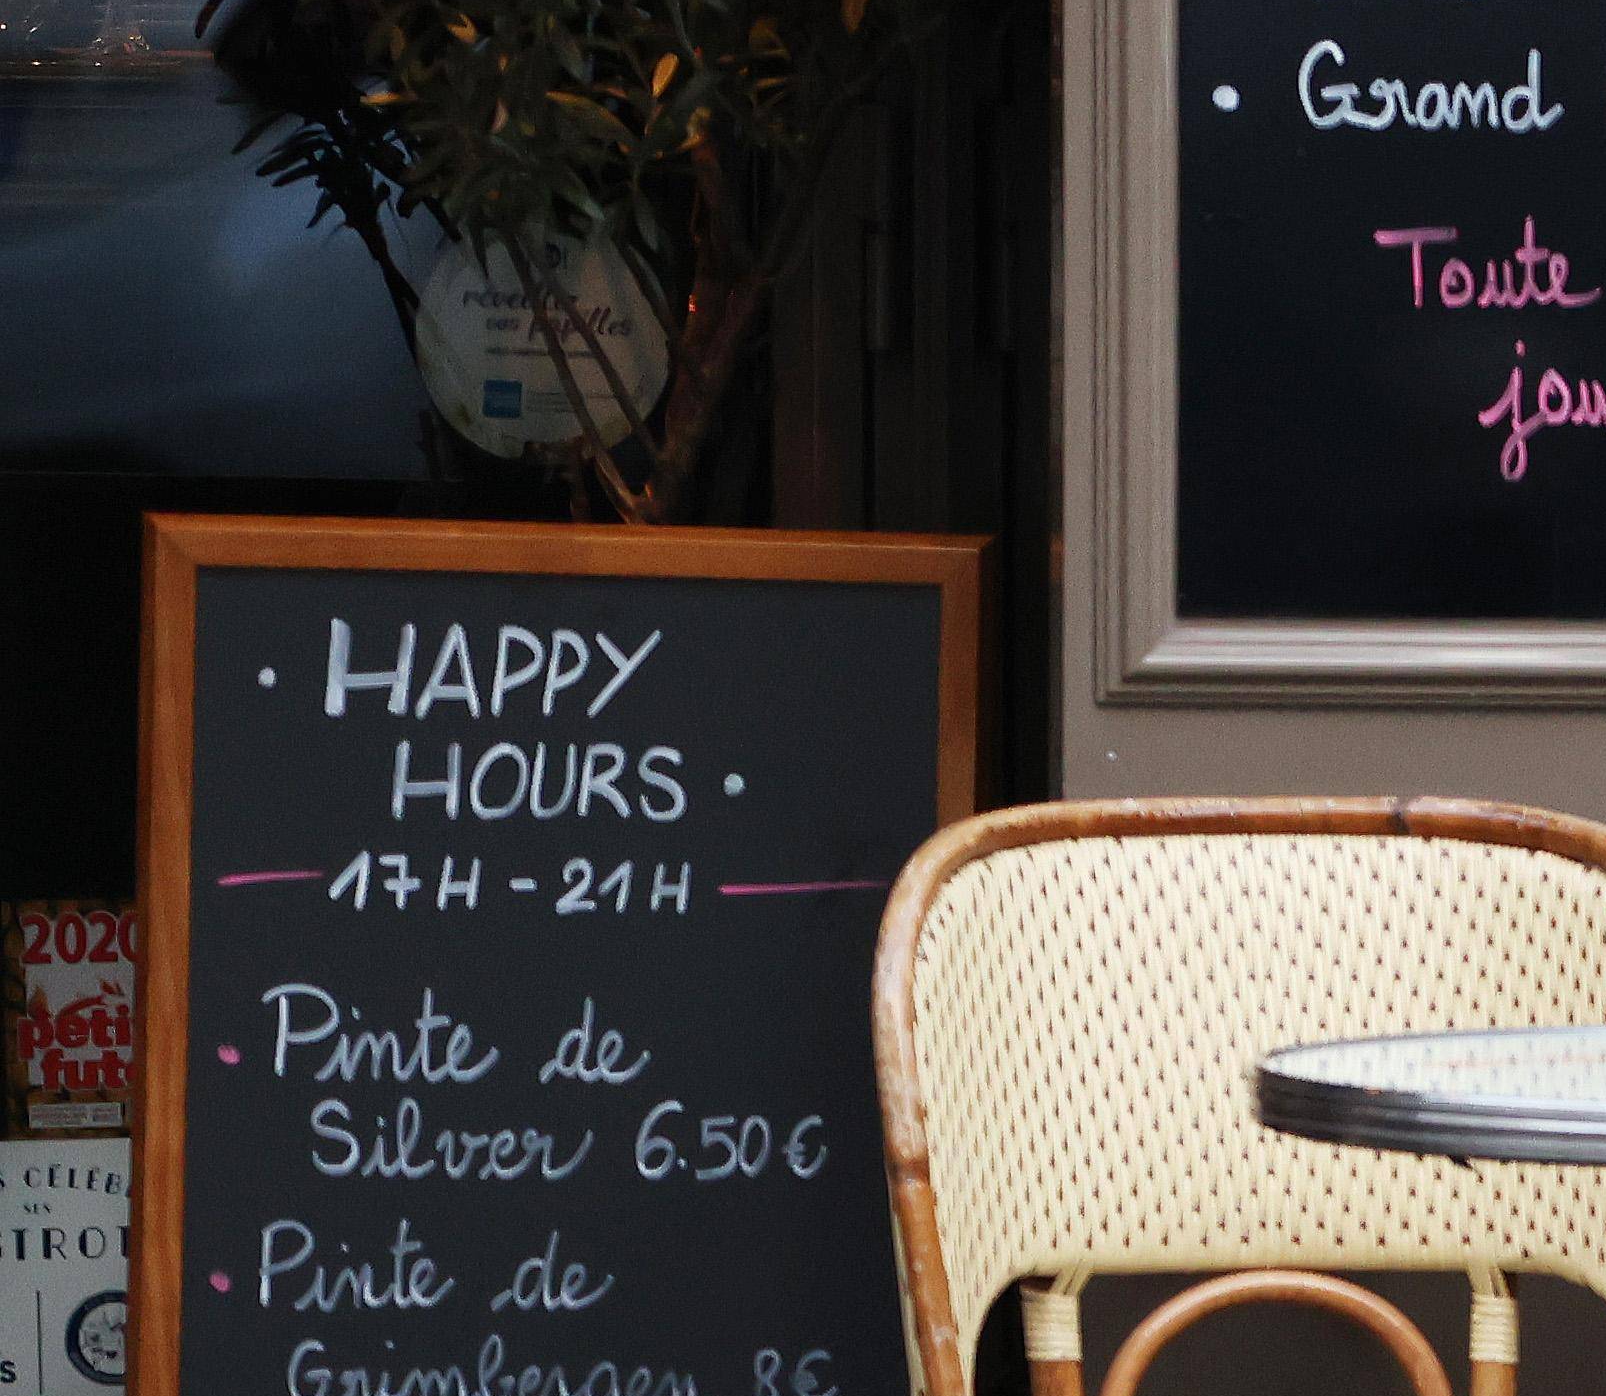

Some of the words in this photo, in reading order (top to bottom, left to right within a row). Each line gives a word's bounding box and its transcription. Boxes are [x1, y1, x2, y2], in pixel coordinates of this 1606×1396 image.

[1298, 40, 1563, 132] Grand
[1374, 216, 1599, 308] Toute
[325, 618, 661, 718] HAPPY
[392, 741, 686, 821] HOURS
[262, 983, 498, 1083] Pinte
[540, 998, 650, 1083] de
[311, 1098, 592, 1179] Silver
[260, 1219, 454, 1312] Pinte
[491, 1231, 613, 1311] de
